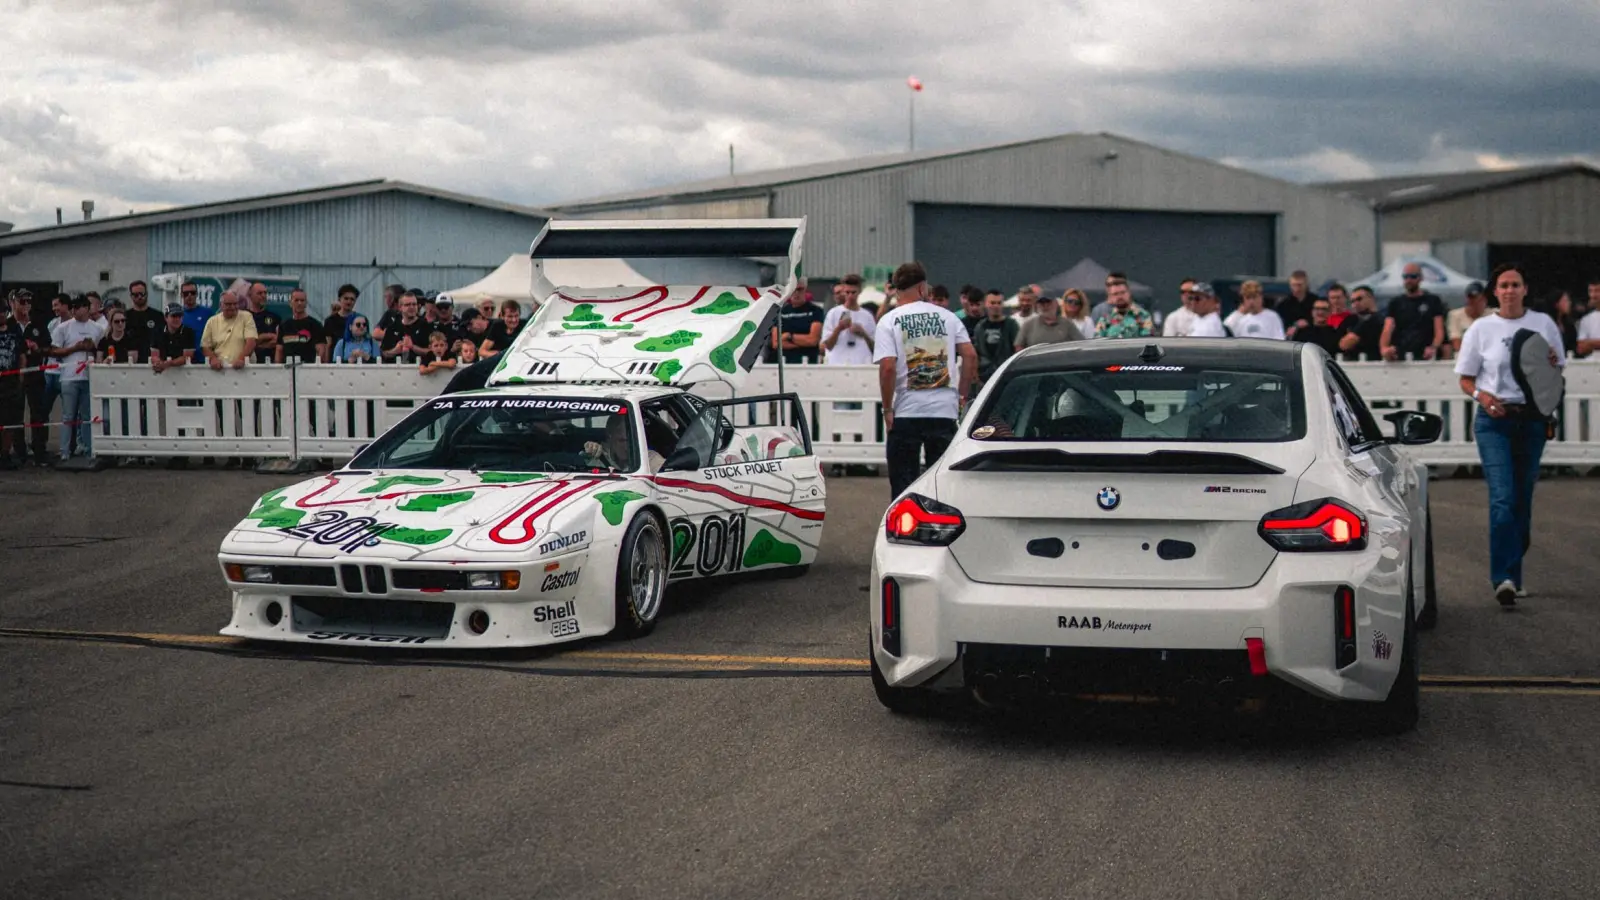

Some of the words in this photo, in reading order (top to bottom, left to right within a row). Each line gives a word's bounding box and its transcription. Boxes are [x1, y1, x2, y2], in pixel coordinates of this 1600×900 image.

[894, 312, 940, 326] AIRFIELD
[901, 319, 946, 331] RUNWAY
[907, 327, 948, 339] REVIVAL
[433, 401, 453, 410] JA
[460, 400, 497, 409] ZUM
[501, 400, 621, 413] NURBURGRING
[704, 466, 744, 480] STUCK
[745, 461, 783, 475] PIQUET
[277, 510, 401, 553] 201
[539, 530, 587, 555] DUNLOP
[668, 512, 747, 578] 201
[540, 566, 581, 593] Castrol
[533, 600, 576, 623] Shell
[551, 618, 580, 638] BBS
[1057, 615, 1102, 630] RAAB
[1102, 619, 1152, 634] Motorsport
